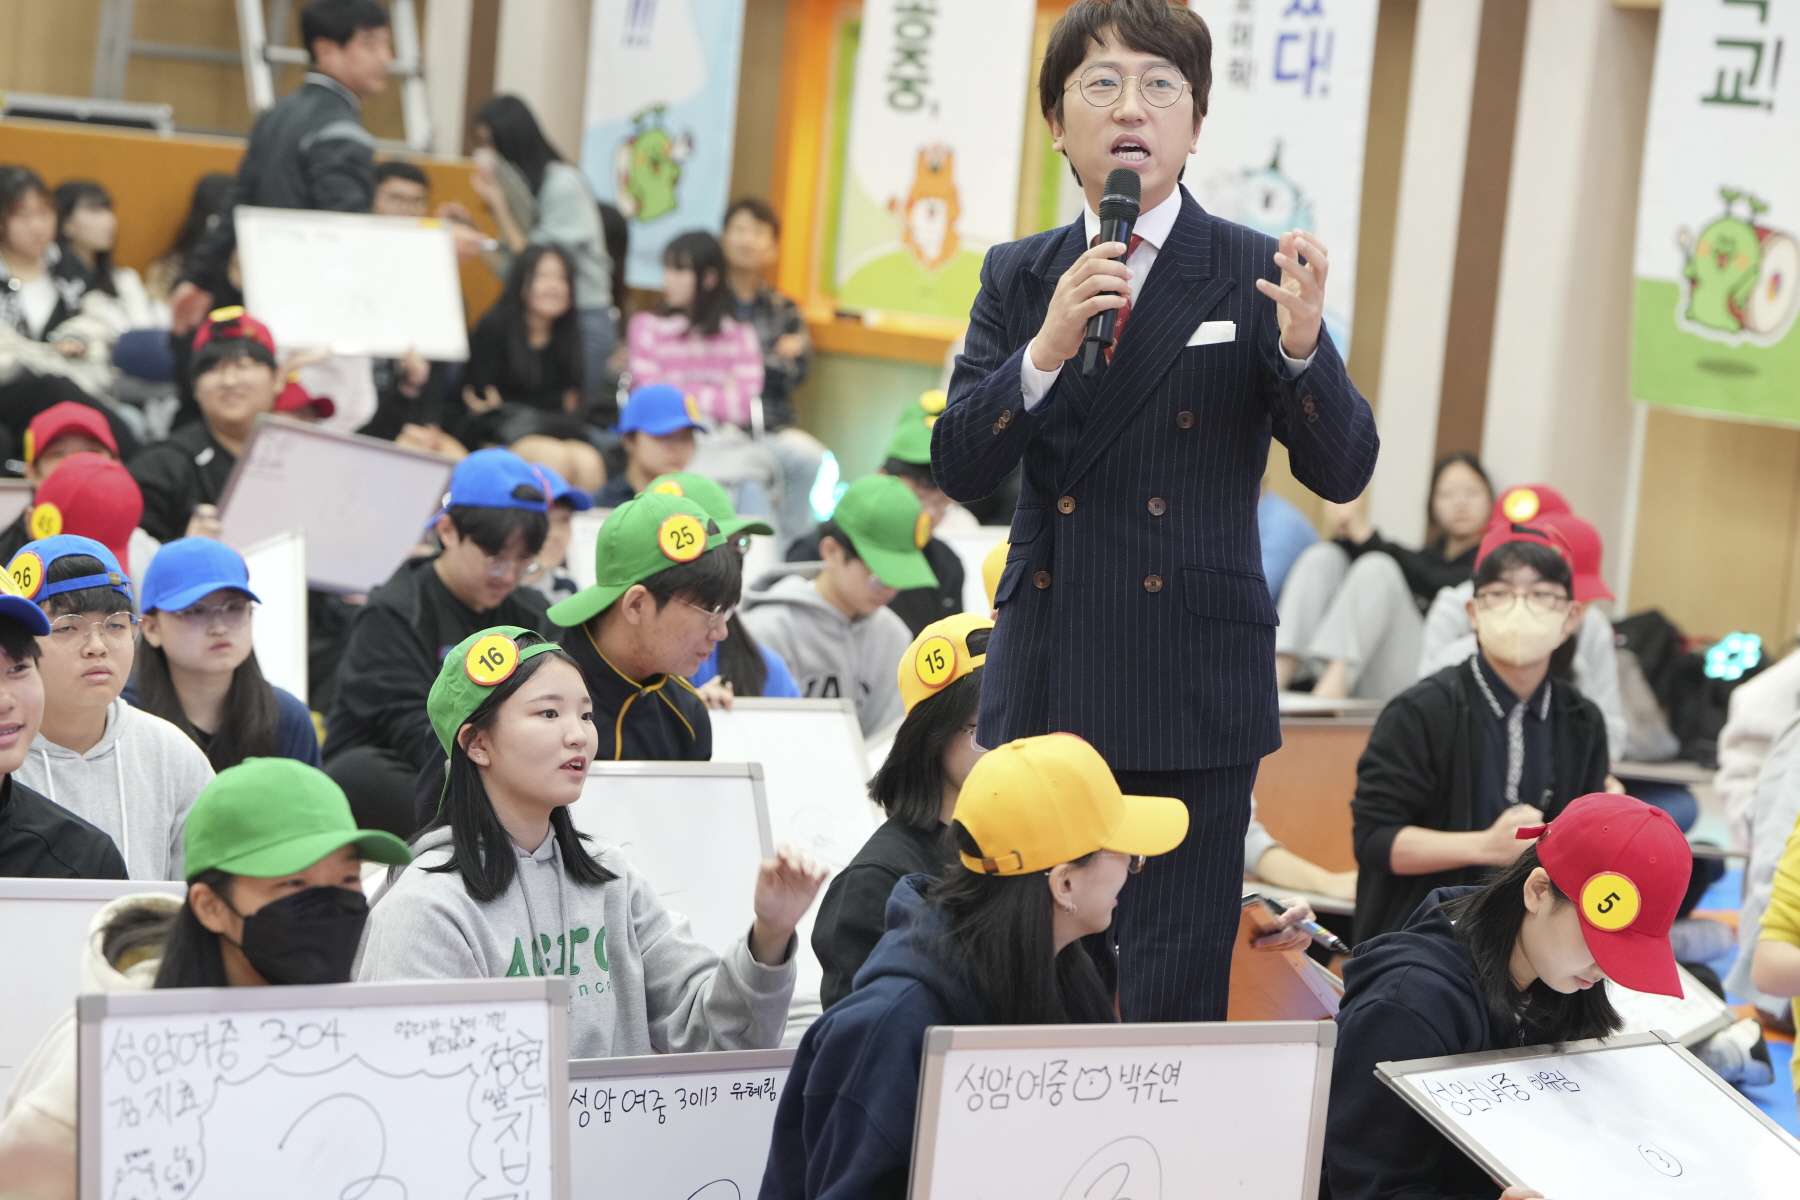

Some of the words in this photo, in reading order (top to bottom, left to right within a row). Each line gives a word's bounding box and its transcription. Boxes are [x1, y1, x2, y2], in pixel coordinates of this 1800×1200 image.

[670, 526, 695, 550] 25
[478, 647, 505, 672] 16
[925, 649, 945, 674] 15
[1597, 892, 1621, 914] 5
[105, 1018, 241, 1084] 성암여중
[260, 1017, 347, 1060] 304
[956, 1060, 1068, 1112] 성암여중
[1120, 1060, 1182, 1104] 박수연
[1421, 1072, 1531, 1116] 성암여중
[568, 1087, 667, 1128] 성암여중
[674, 1087, 718, 1110] 30113
